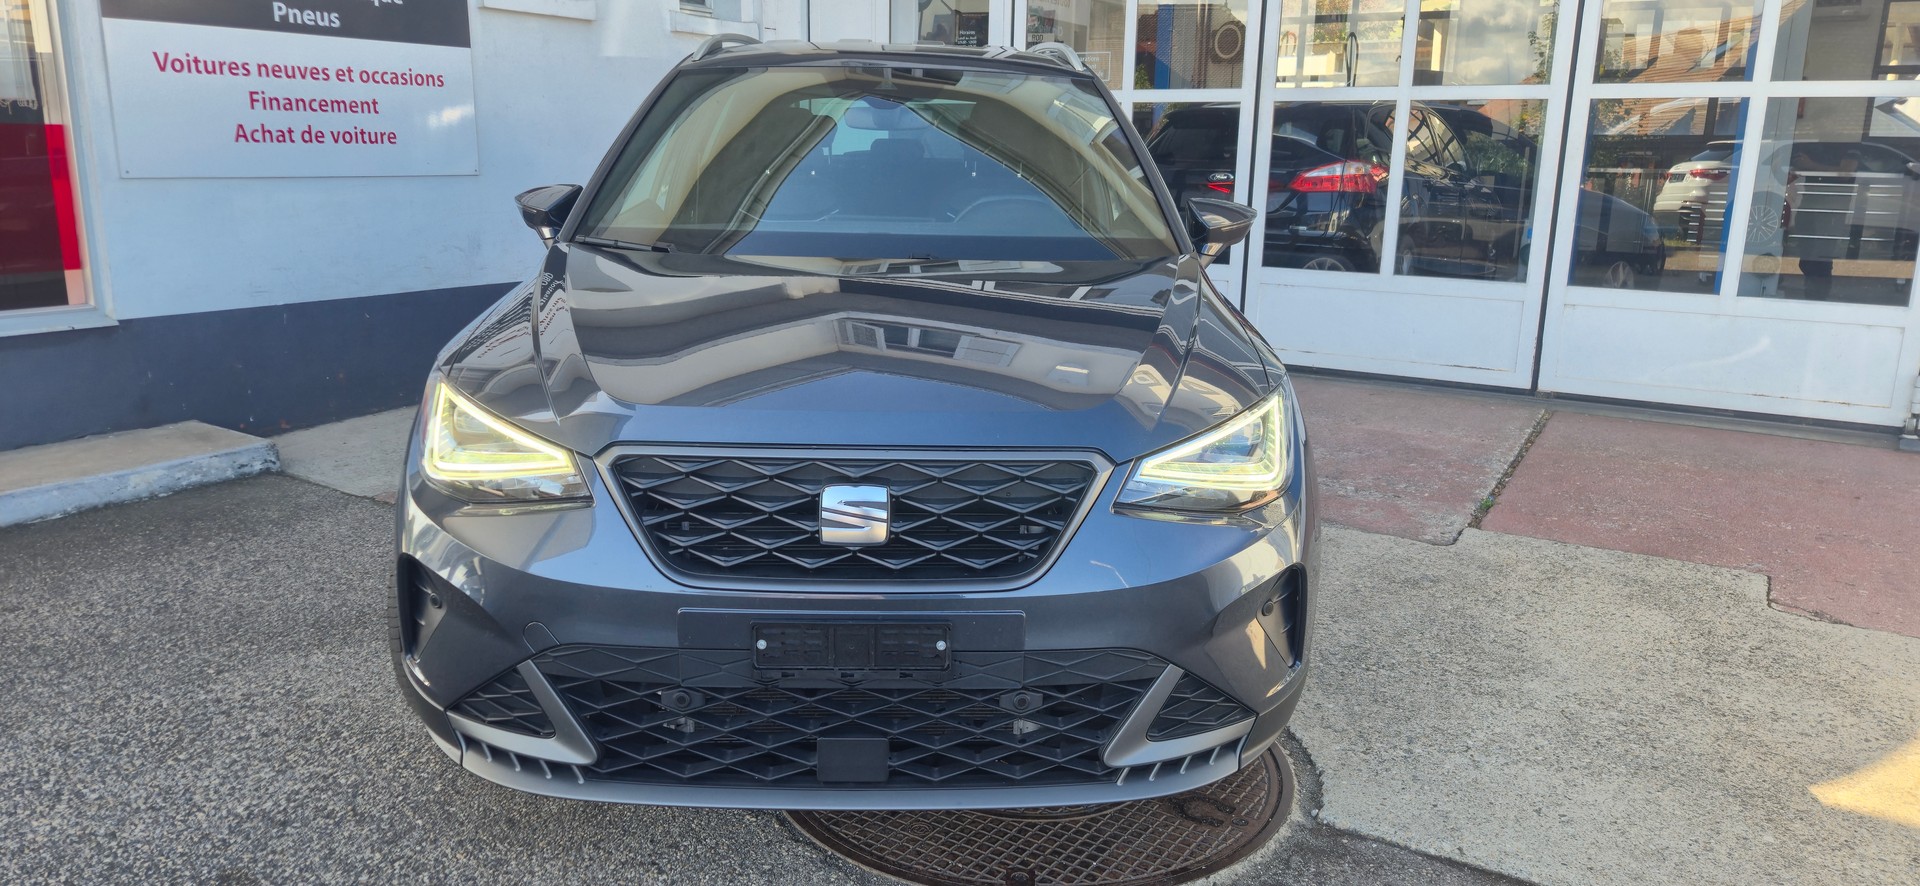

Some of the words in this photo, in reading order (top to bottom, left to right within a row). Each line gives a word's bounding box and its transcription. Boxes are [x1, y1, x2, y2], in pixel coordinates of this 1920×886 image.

[272, 1, 341, 28] Pneus
[152, 51, 251, 77] Voitures
[256, 61, 331, 81] neuves
[335, 66, 355, 83] et
[358, 68, 445, 88] occasions
[248, 90, 380, 115] Financement
[234, 122, 296, 144] Achat
[300, 124, 326, 144] de
[330, 126, 398, 145] voiture
